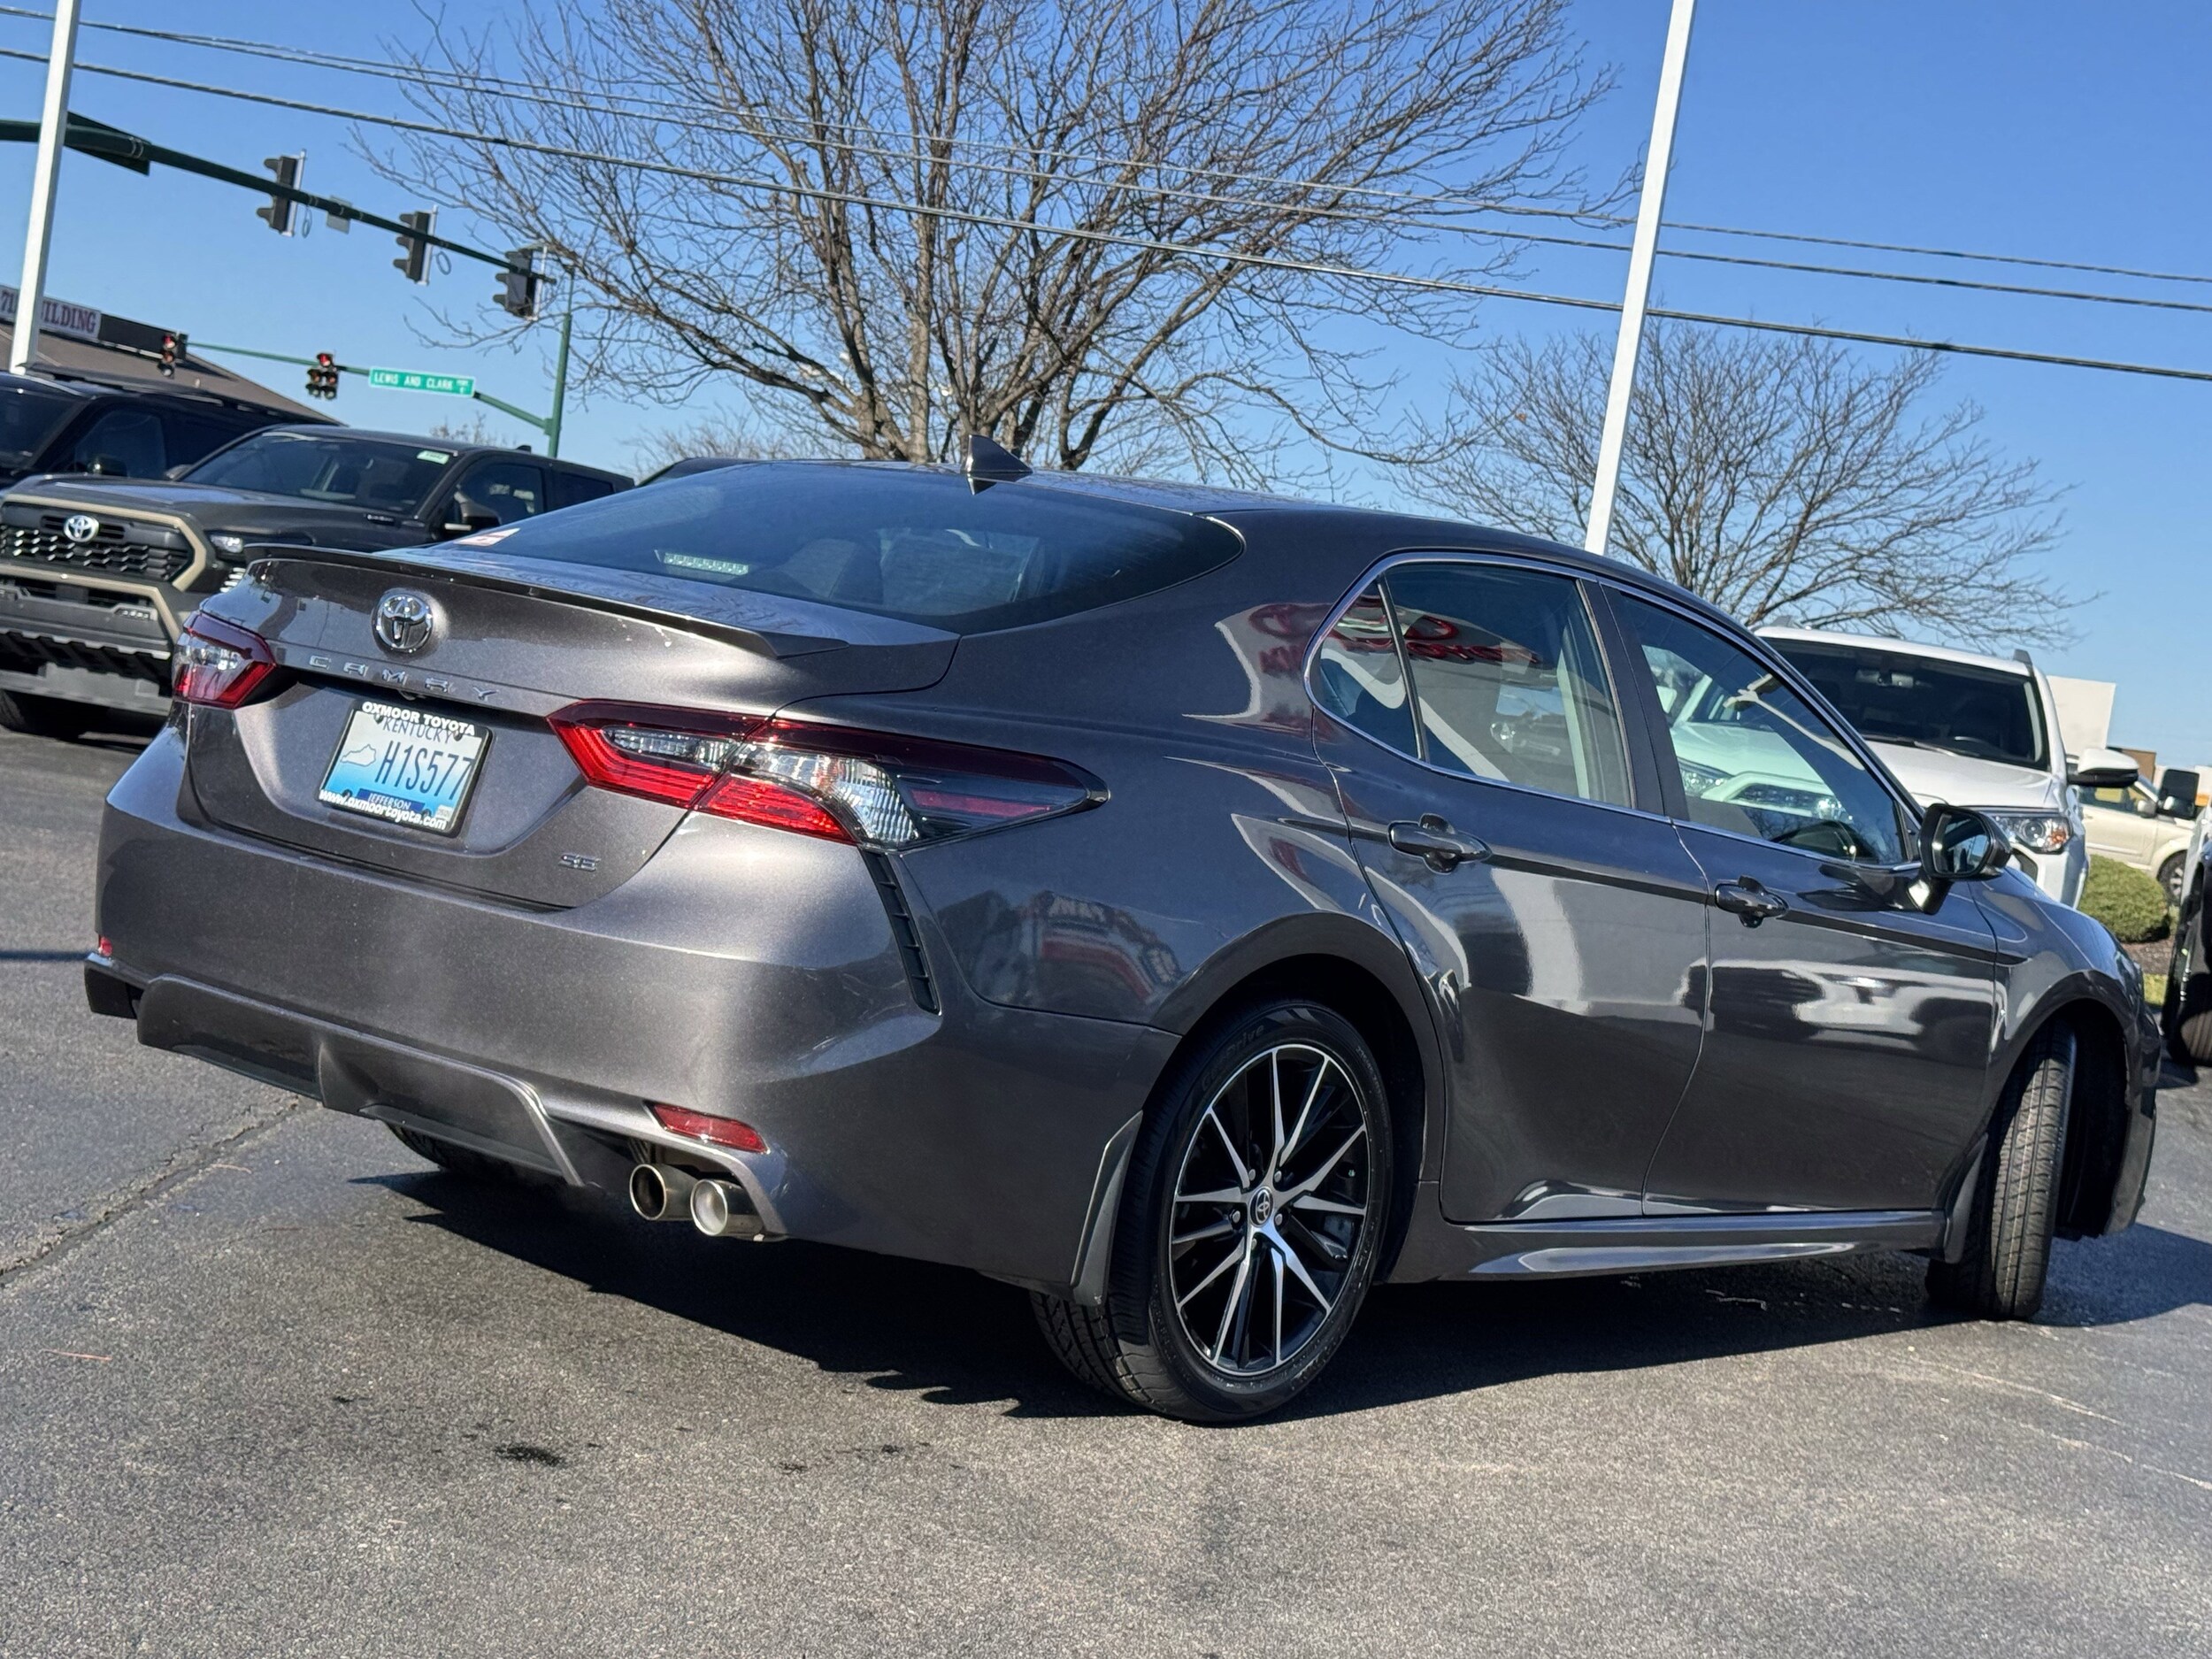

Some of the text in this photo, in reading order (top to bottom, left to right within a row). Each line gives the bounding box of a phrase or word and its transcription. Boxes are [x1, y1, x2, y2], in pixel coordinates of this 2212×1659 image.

[374, 372, 399, 385] LEWIS
[403, 374, 422, 387] AND
[426, 377, 453, 390] CLARK
[309, 655, 499, 701] CAMRY
[361, 701, 475, 736] OXMOOR TOYOTA
[382, 717, 453, 744] KENTUCKY
[374, 740, 473, 801] H1S577
[319, 789, 447, 830] www.oxmoortoyota.com
[367, 792, 412, 810] JEFFERSON
[560, 854, 595, 872] SE
